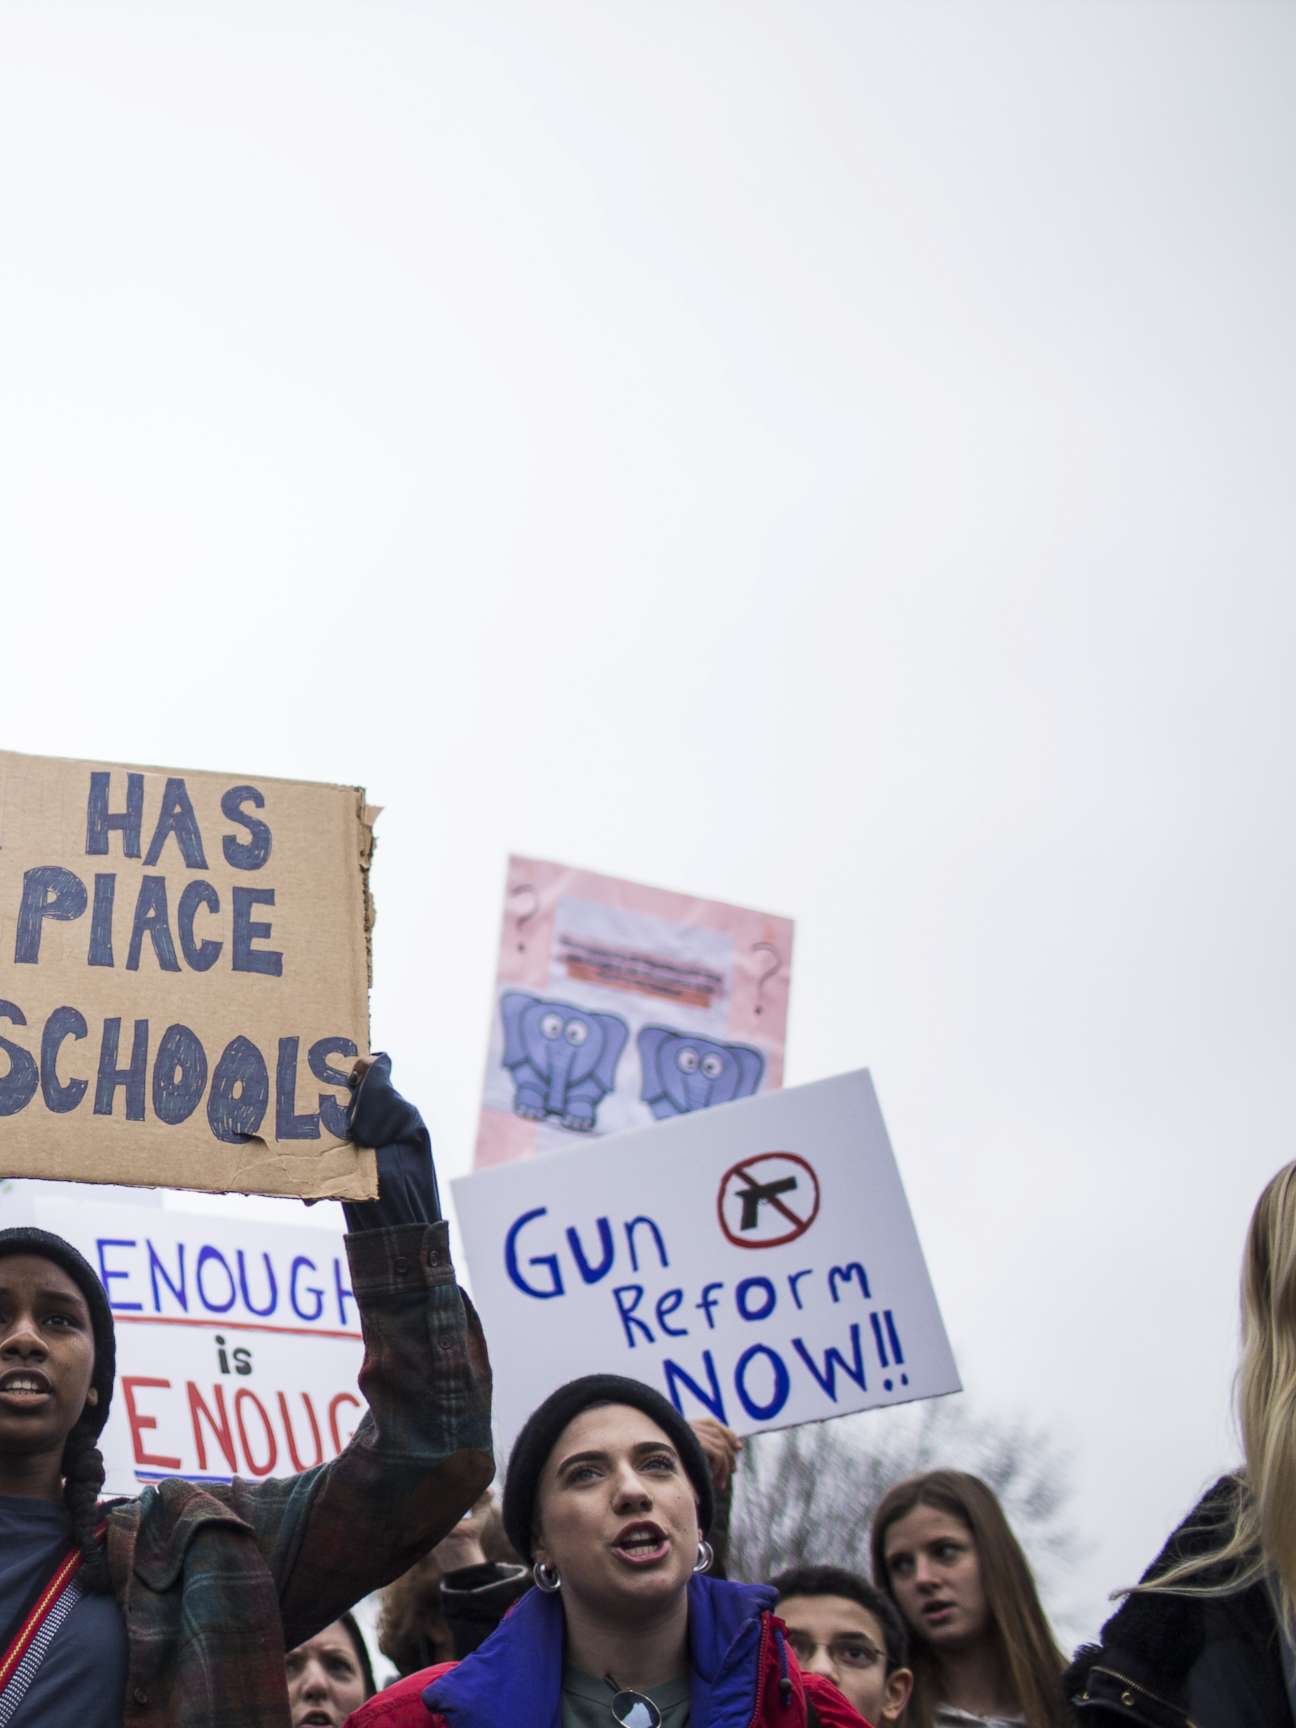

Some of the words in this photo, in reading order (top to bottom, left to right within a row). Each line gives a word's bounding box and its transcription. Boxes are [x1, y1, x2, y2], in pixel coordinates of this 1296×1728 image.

[85, 770, 272, 871] HAS
[504, 1206, 669, 1300] Gun
[613, 1261, 872, 1349] Reform
[214, 1334, 253, 1376] is
[663, 1309, 910, 1427] NOW!!
[121, 1376, 361, 1477] ENOUG
